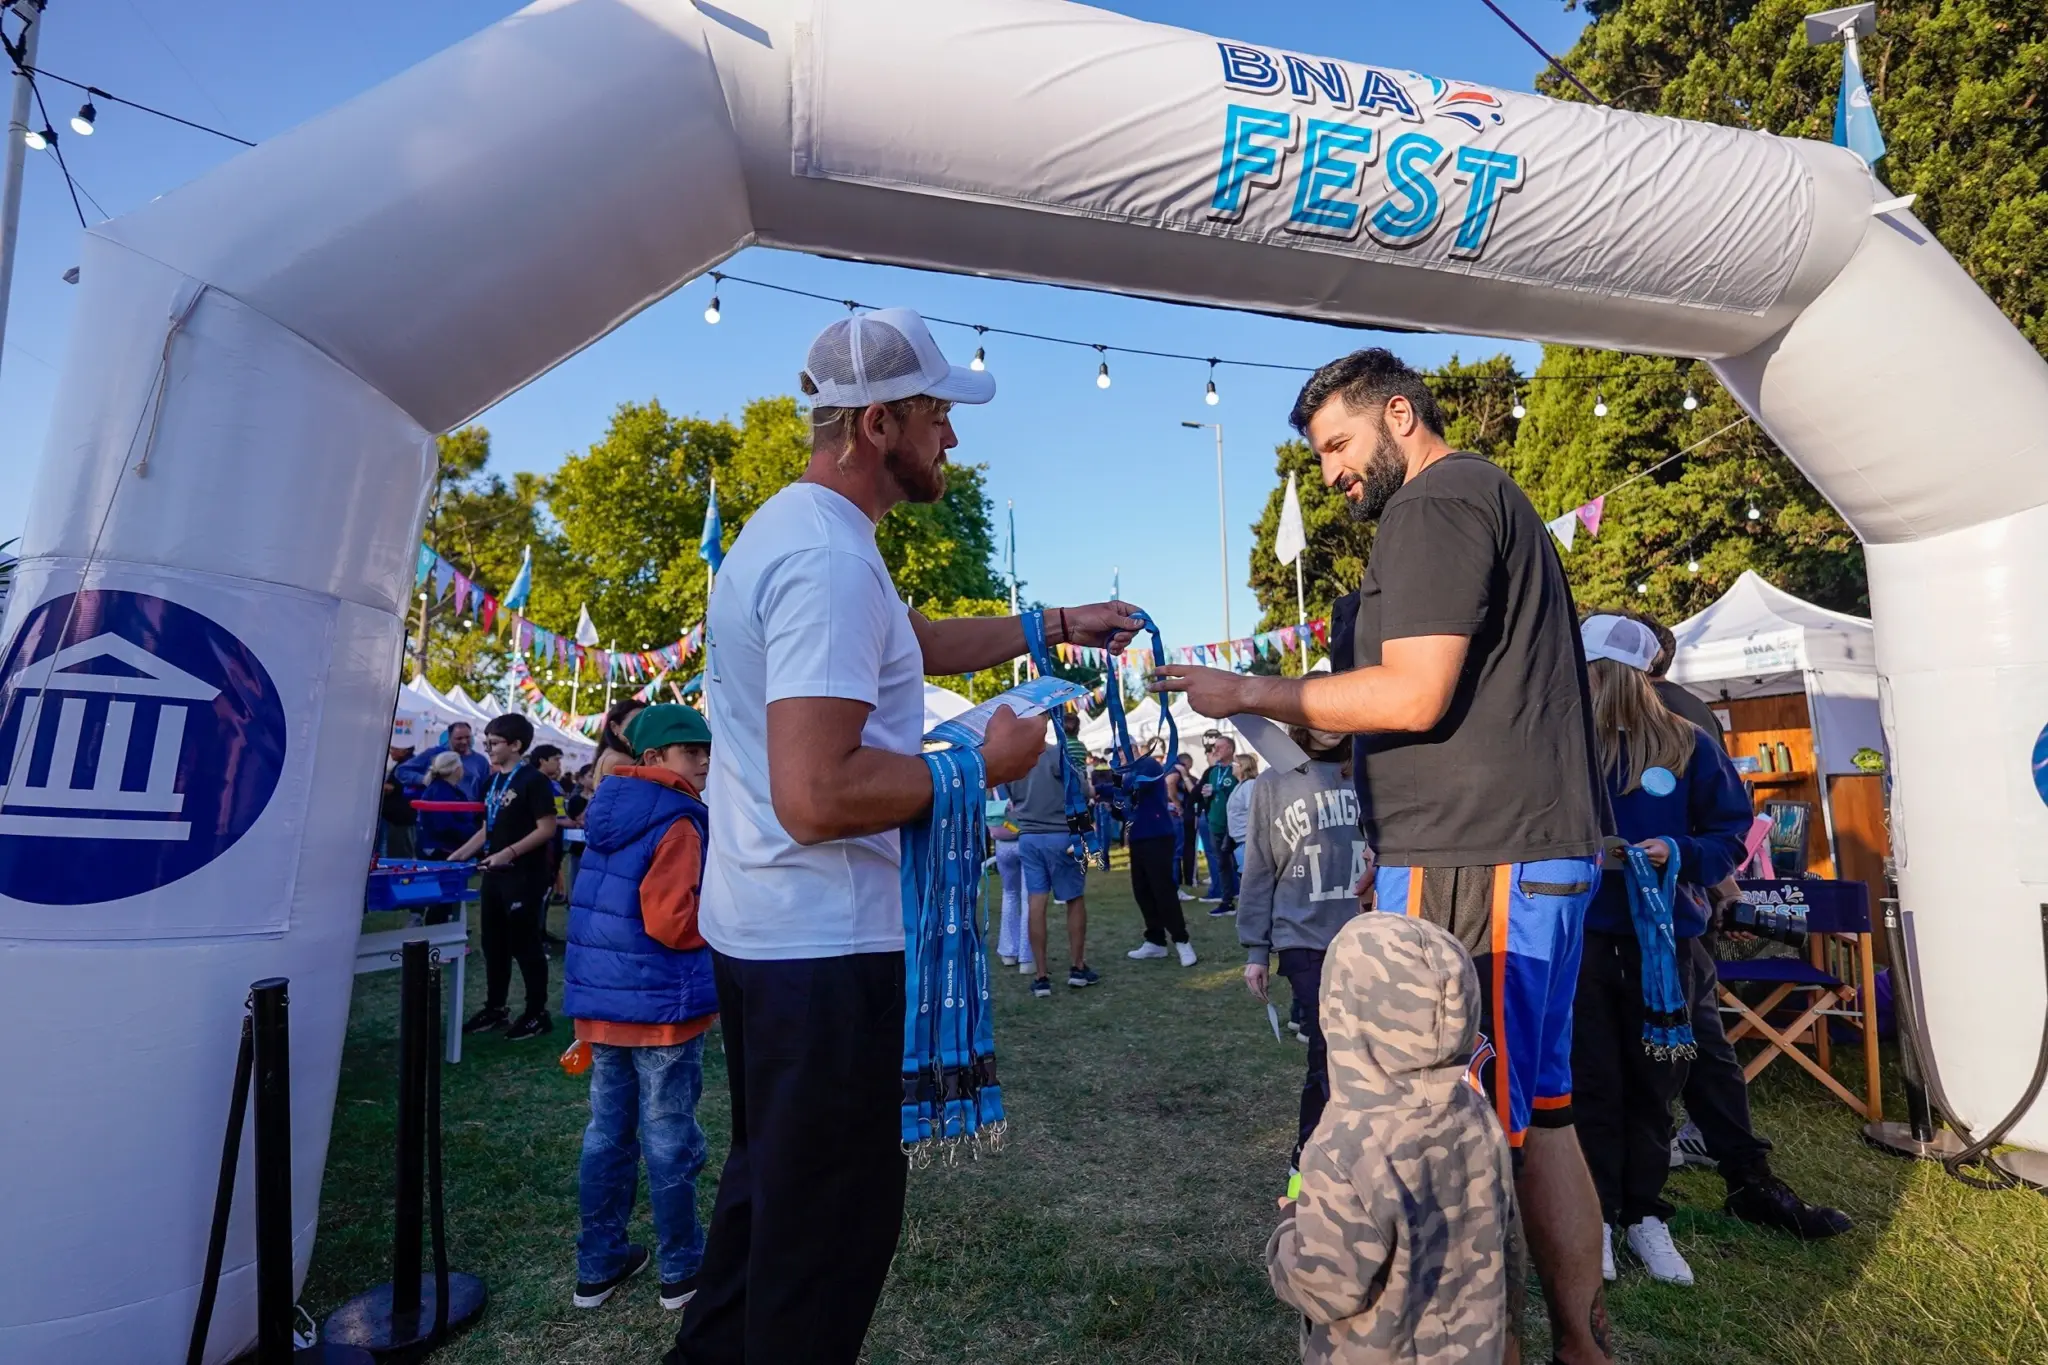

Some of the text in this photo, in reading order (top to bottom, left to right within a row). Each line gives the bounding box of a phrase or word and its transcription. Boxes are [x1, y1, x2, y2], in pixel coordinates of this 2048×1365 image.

[1217, 42, 1422, 122] BNA
[1208, 104, 1525, 259] FEST
[1275, 789, 1361, 852] LOS ANG
[948, 886, 956, 905] Nación
[1291, 865, 1305, 878] 19
